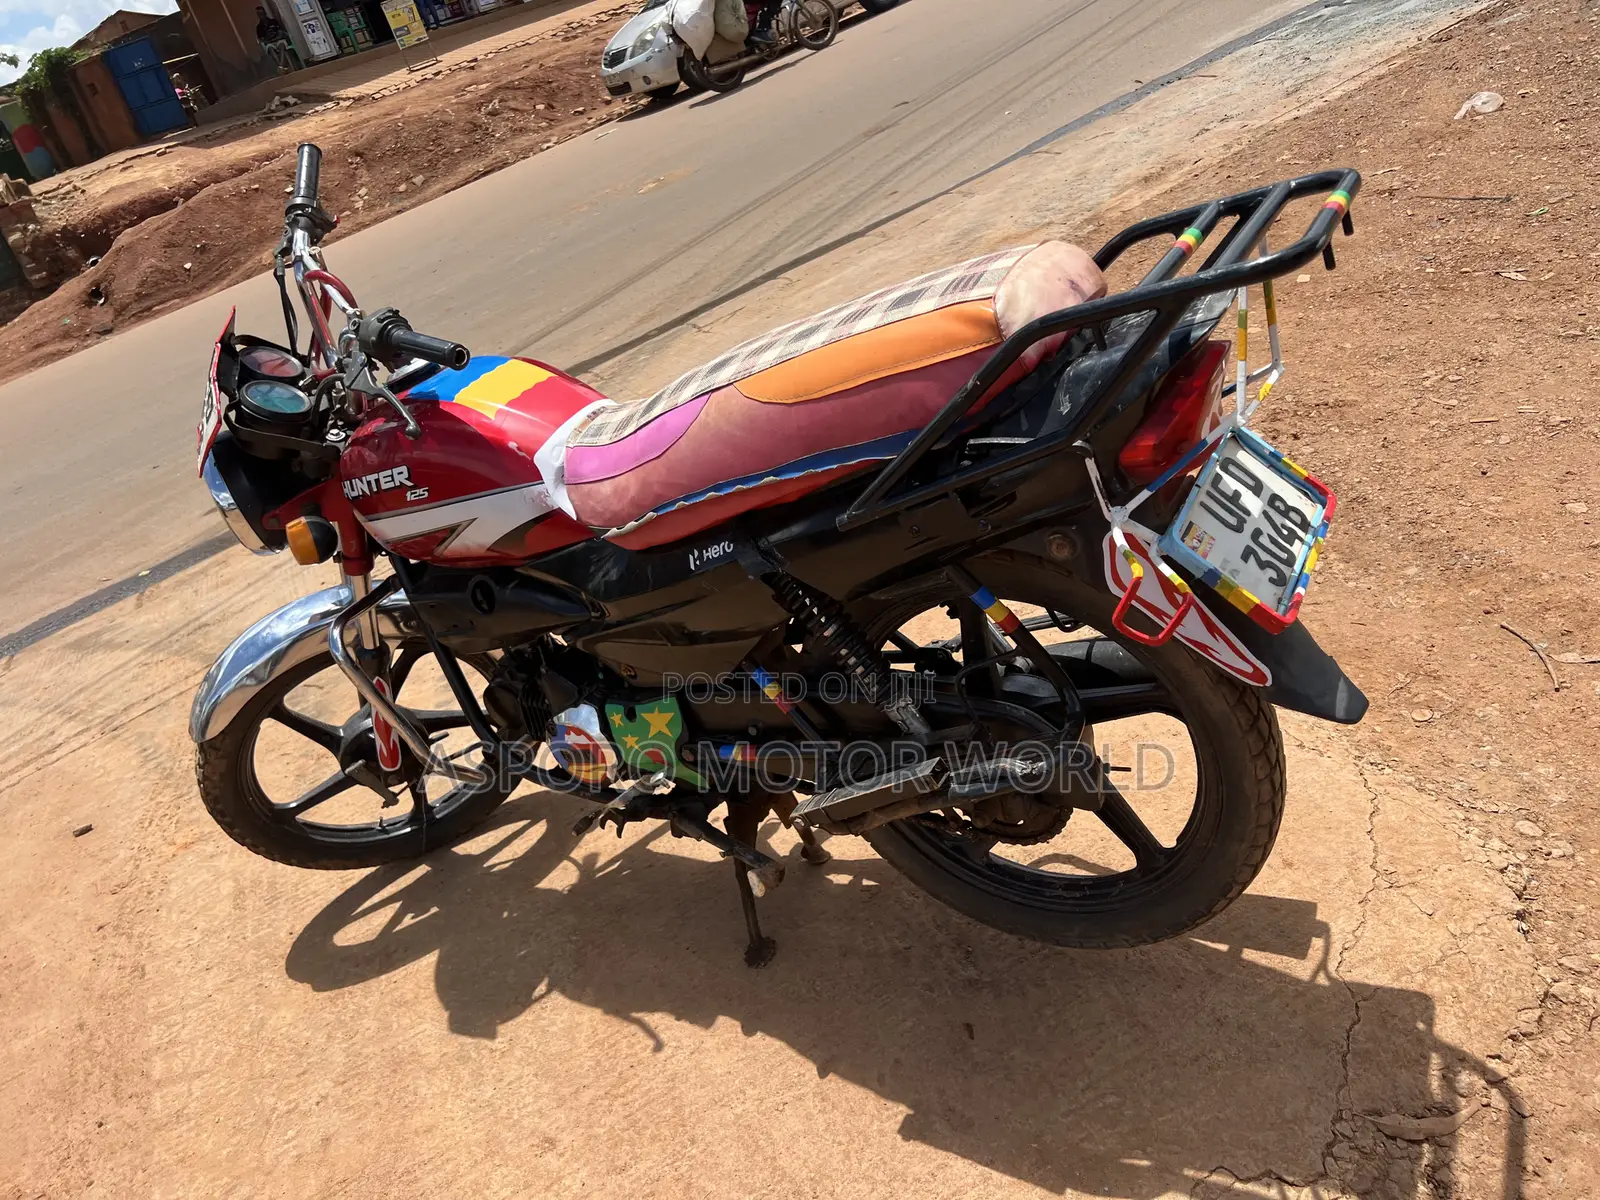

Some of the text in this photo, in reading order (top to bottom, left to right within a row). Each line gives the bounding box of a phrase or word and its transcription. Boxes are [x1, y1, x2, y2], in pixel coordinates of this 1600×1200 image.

[341, 465, 429, 502] HUNTER 125
[1200, 457, 1264, 533] UFD
